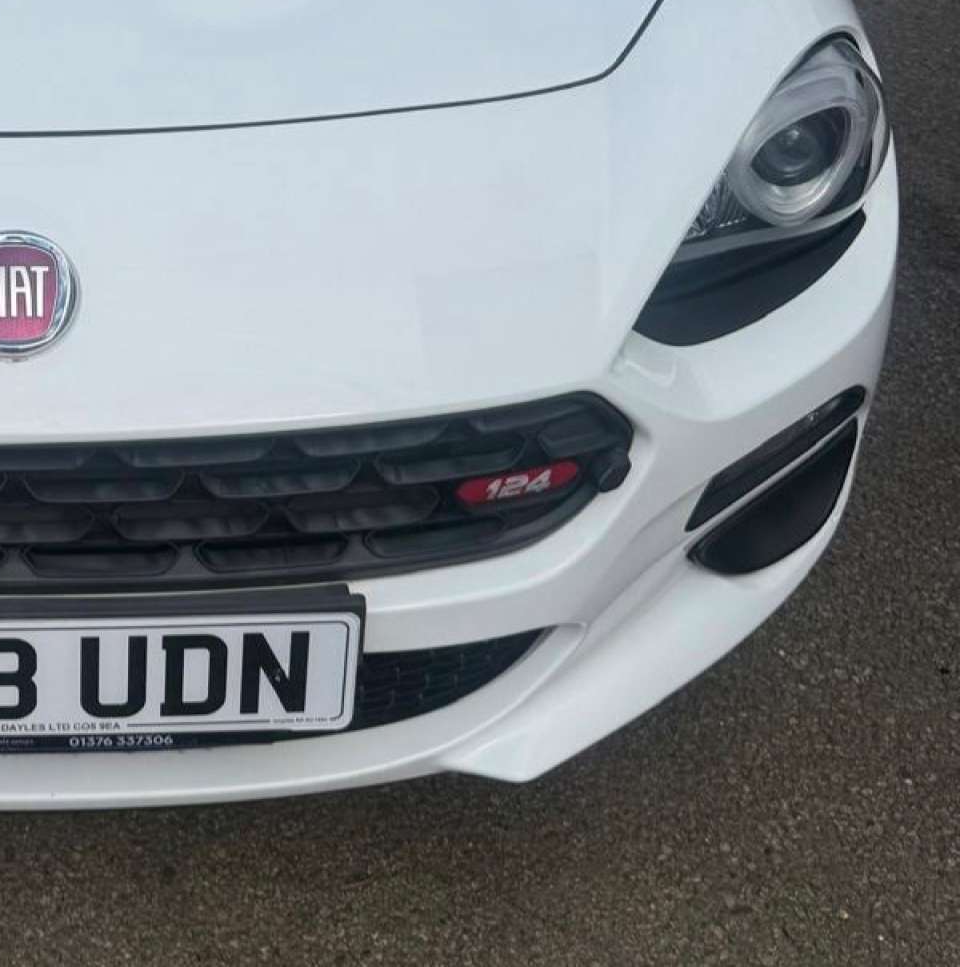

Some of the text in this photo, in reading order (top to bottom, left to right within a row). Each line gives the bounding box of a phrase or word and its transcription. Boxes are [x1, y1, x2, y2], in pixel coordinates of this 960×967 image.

[486, 469, 552, 501] 124
[79, 631, 310, 718] UDN
[1, 723, 44, 733] DAYLES
[48, 722, 71, 732] LTD
[69, 734, 174, 748] 01376 337306
